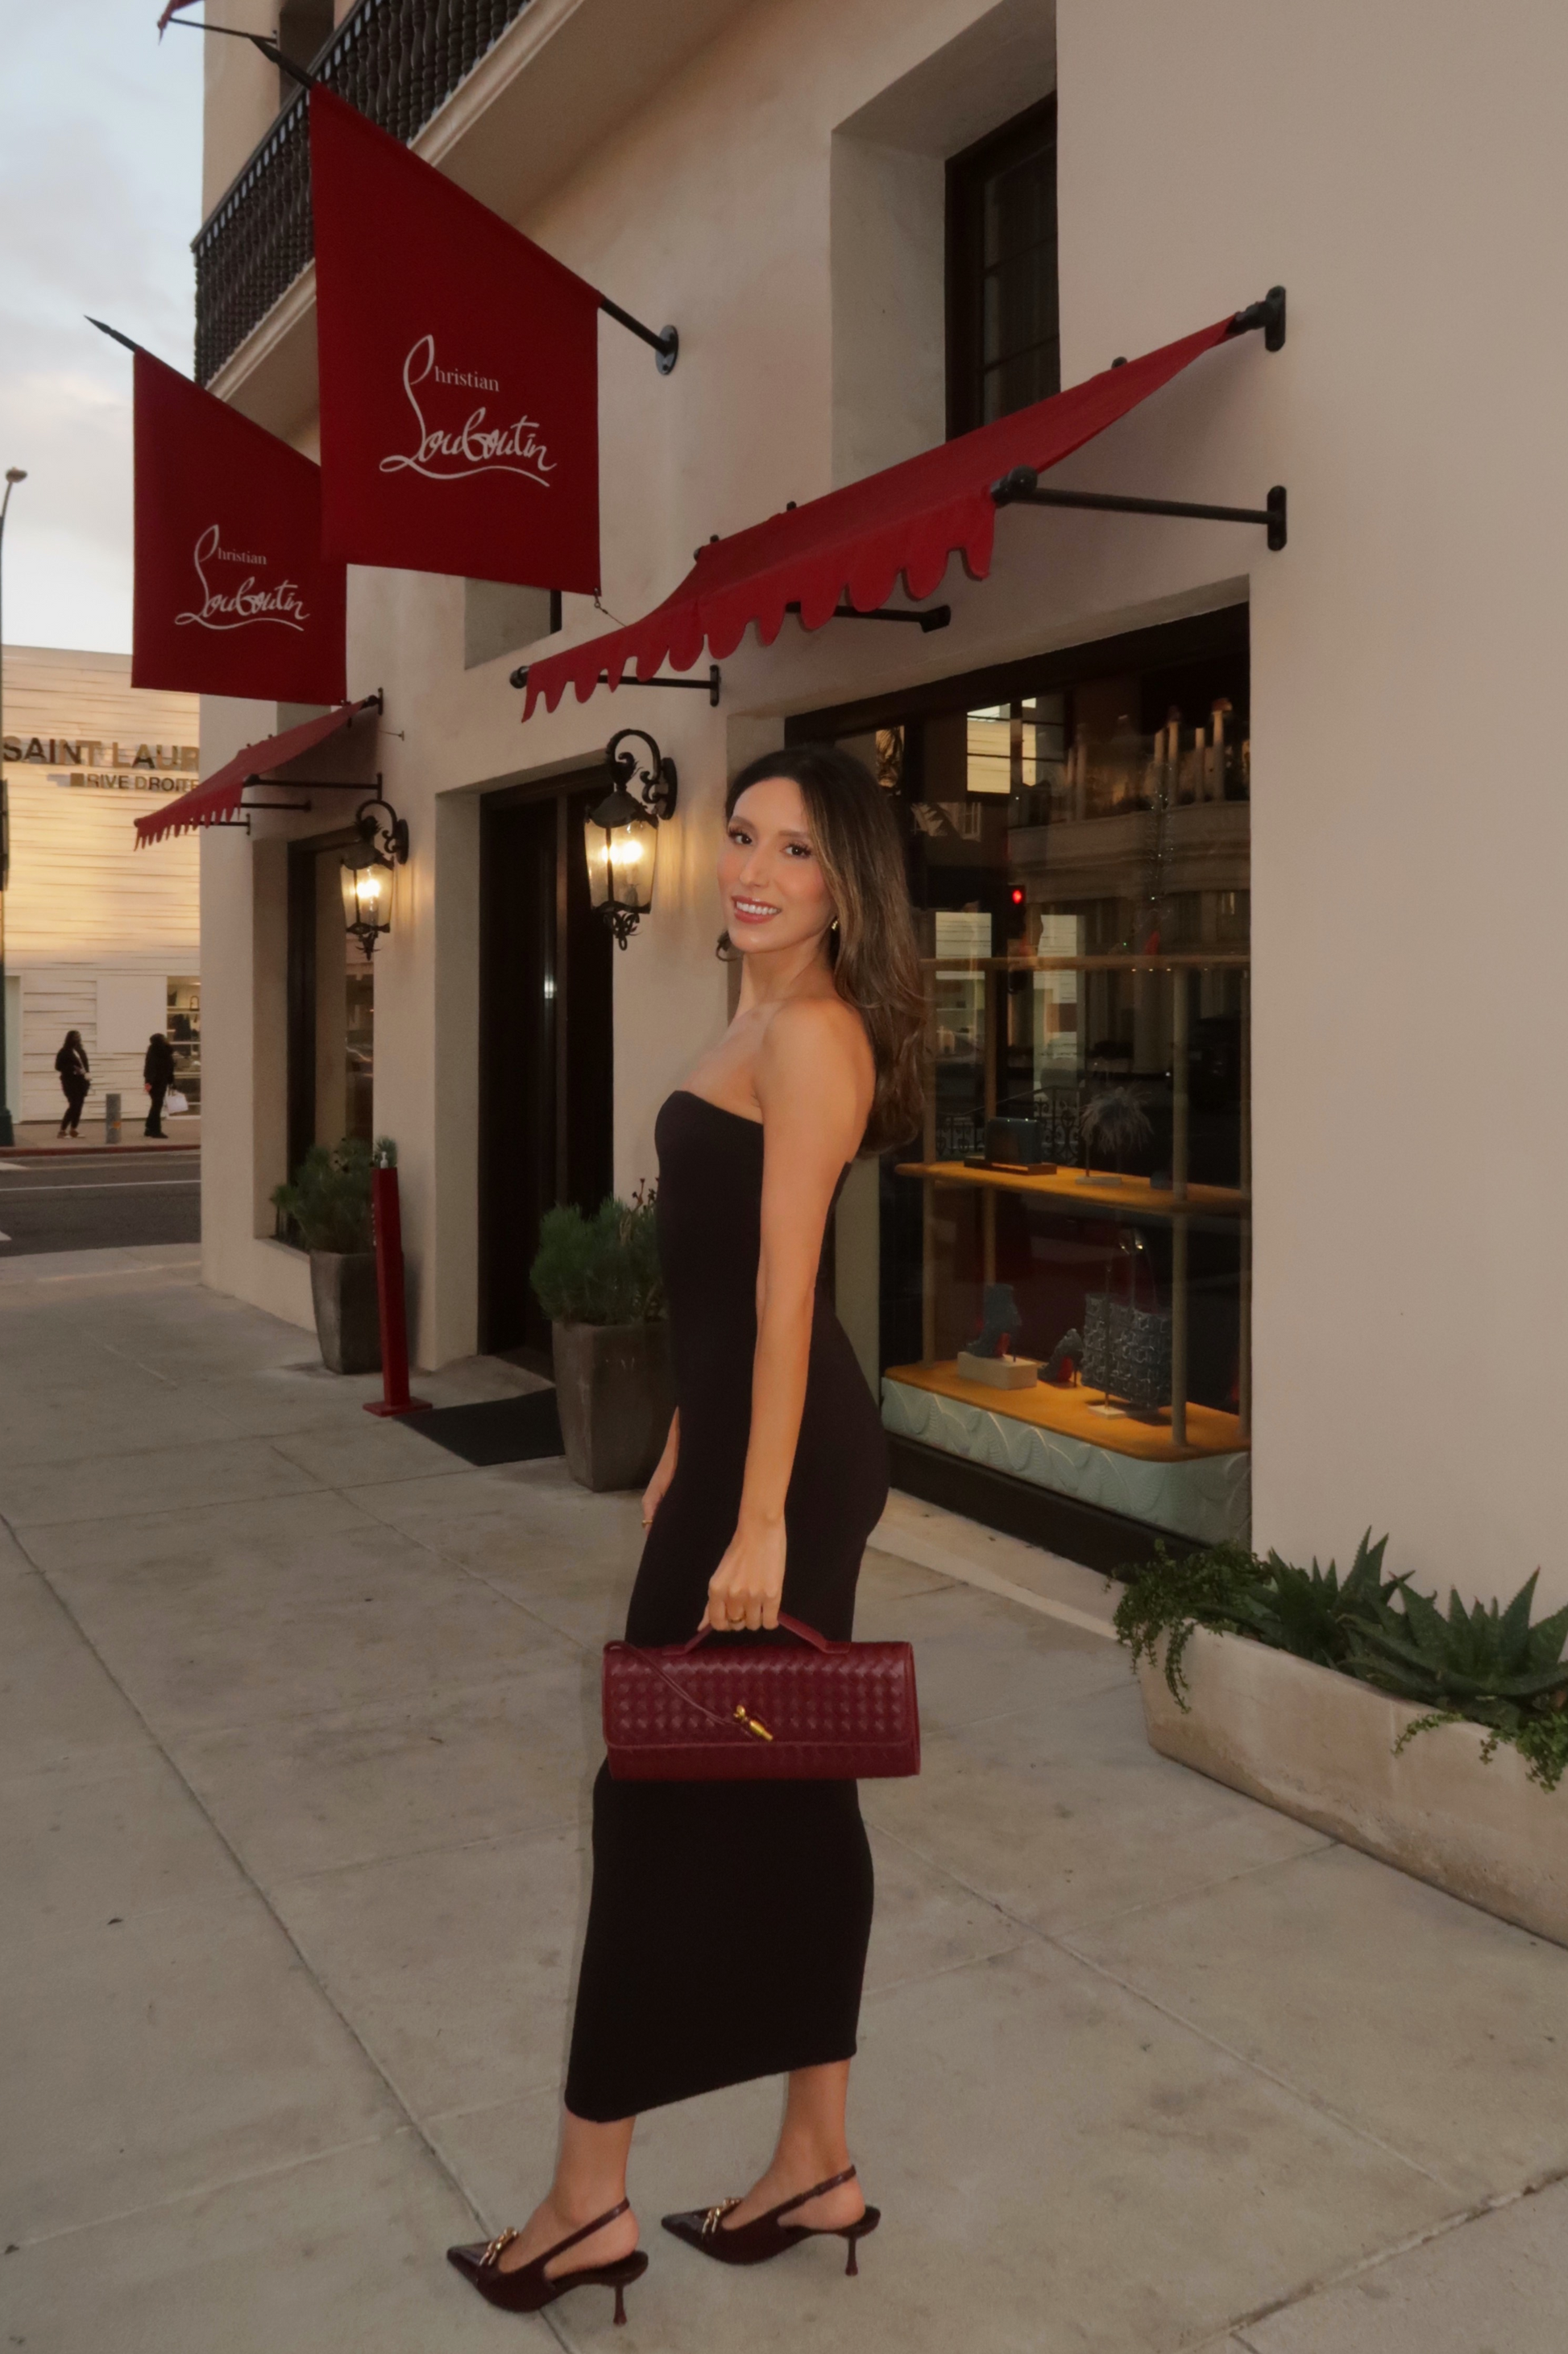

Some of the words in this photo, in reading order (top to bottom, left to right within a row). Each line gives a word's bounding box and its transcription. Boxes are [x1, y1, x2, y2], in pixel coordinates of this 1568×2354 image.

[379, 334, 558, 488] Louboutin
[174, 525, 311, 632] Louboutin
[2, 735, 102, 767] SAINT
[87, 773, 129, 789] RIVE
